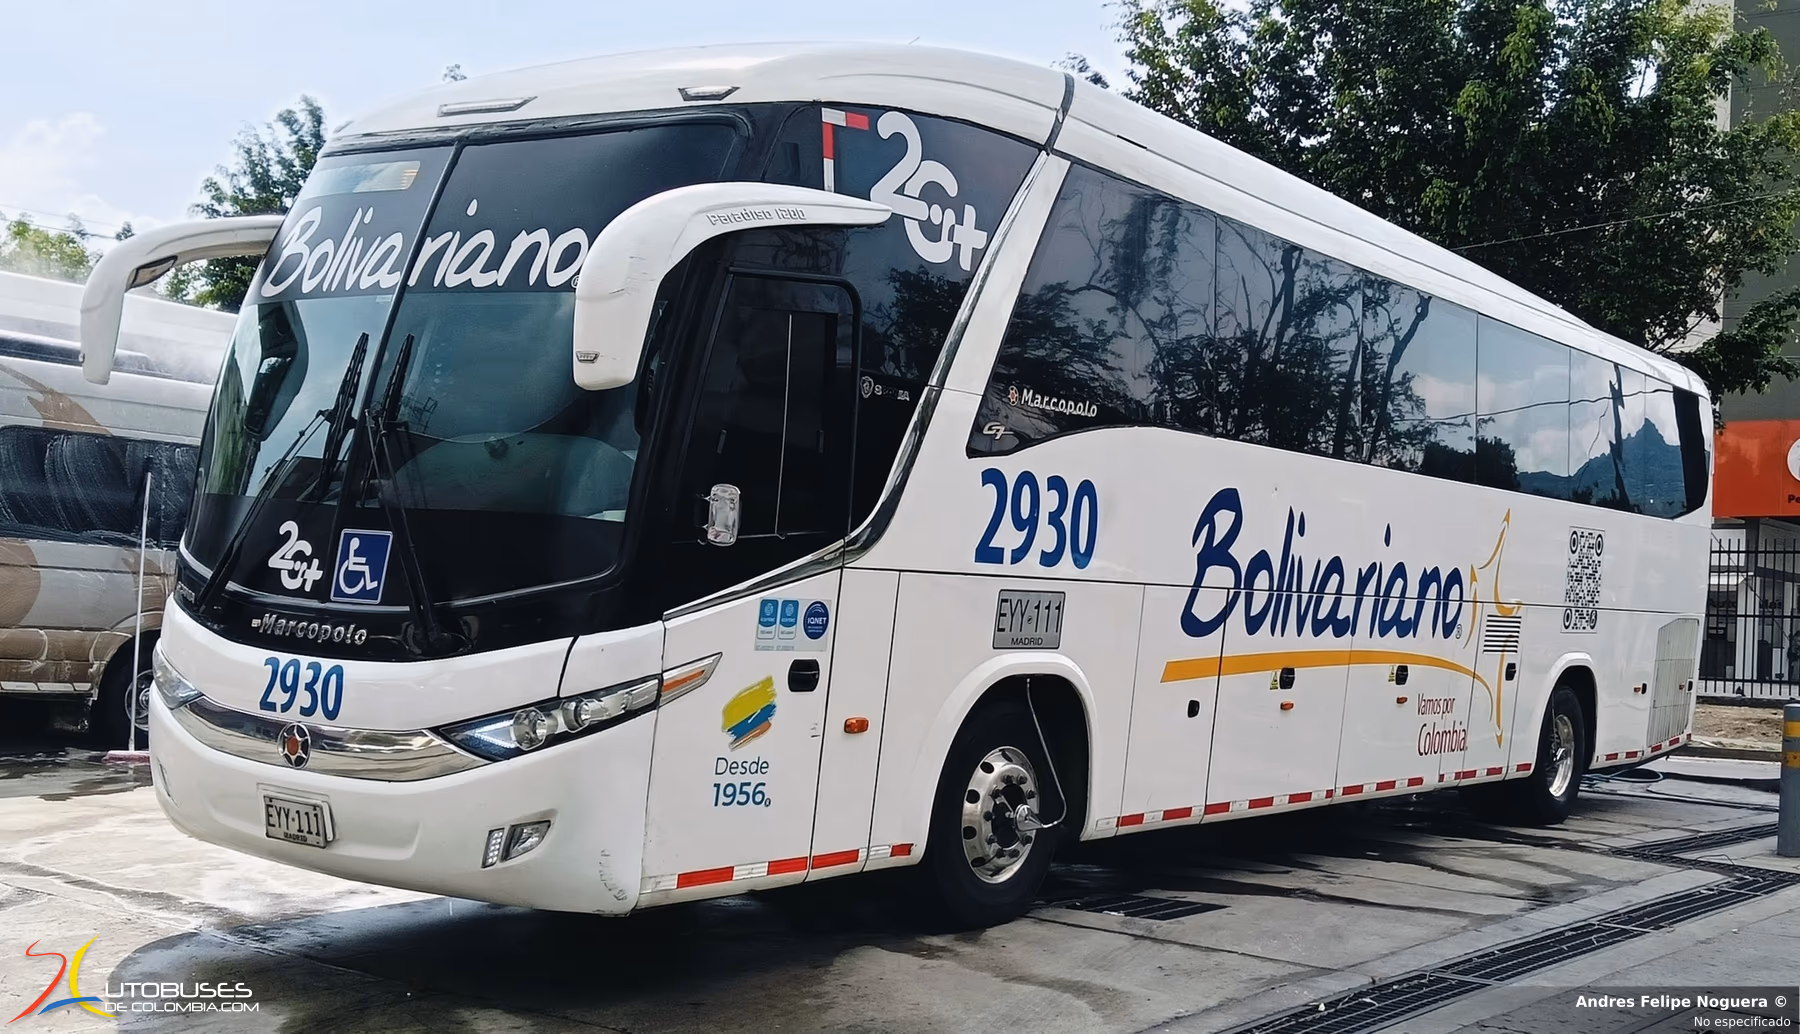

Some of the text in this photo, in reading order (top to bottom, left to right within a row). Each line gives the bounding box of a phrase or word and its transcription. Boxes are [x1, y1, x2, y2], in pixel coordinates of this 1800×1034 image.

[706, 207, 807, 226] Paradiso 1200
[261, 198, 588, 298] Bolivariano
[1021, 388, 1098, 418] Marcopolo
[974, 467, 1098, 570] 2930
[1180, 487, 1464, 639] Bolivariano
[258, 612, 368, 646] Marcopolo
[1010, 637, 1044, 646] MADRID
[259, 656, 345, 721] 2930
[1417, 692, 1456, 720] Vamos por
[714, 755, 770, 776] Desde
